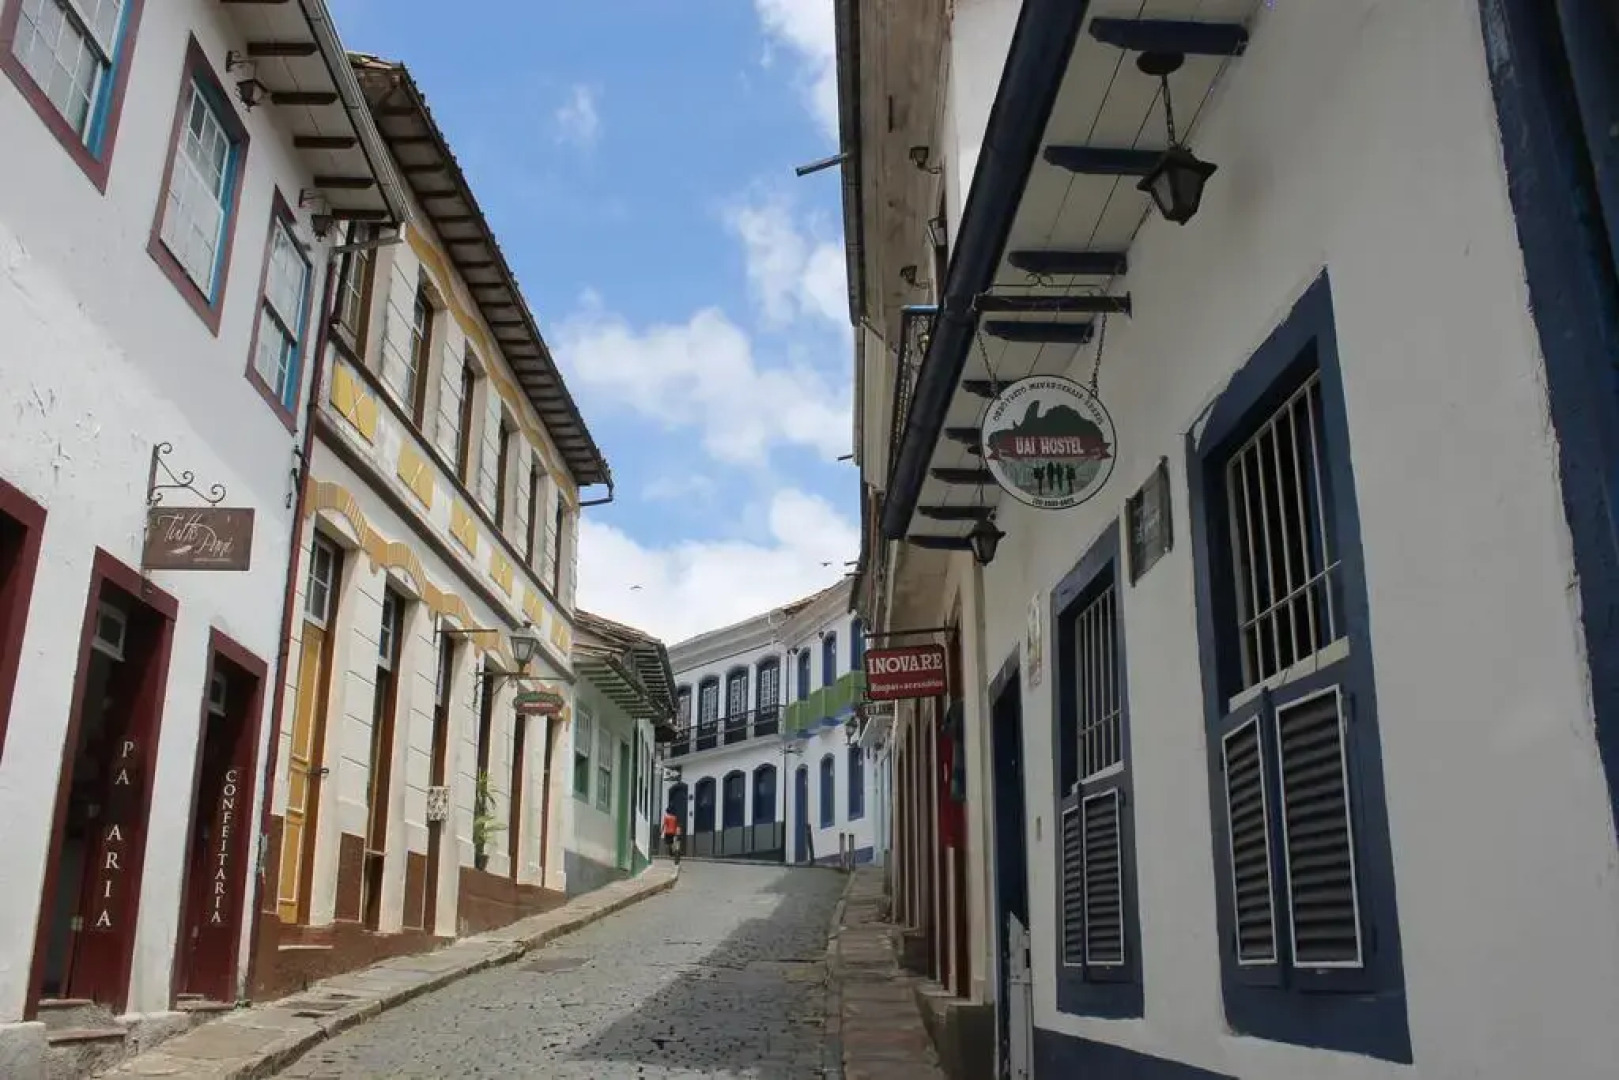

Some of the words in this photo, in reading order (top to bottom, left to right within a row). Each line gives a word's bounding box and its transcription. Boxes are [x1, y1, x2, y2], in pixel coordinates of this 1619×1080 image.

[1015, 436, 1036, 455] UAI
[1041, 436, 1085, 455] HOSTEL
[868, 653, 943, 675] INOVARE
[211, 769, 237, 923] CONFEITARIA
